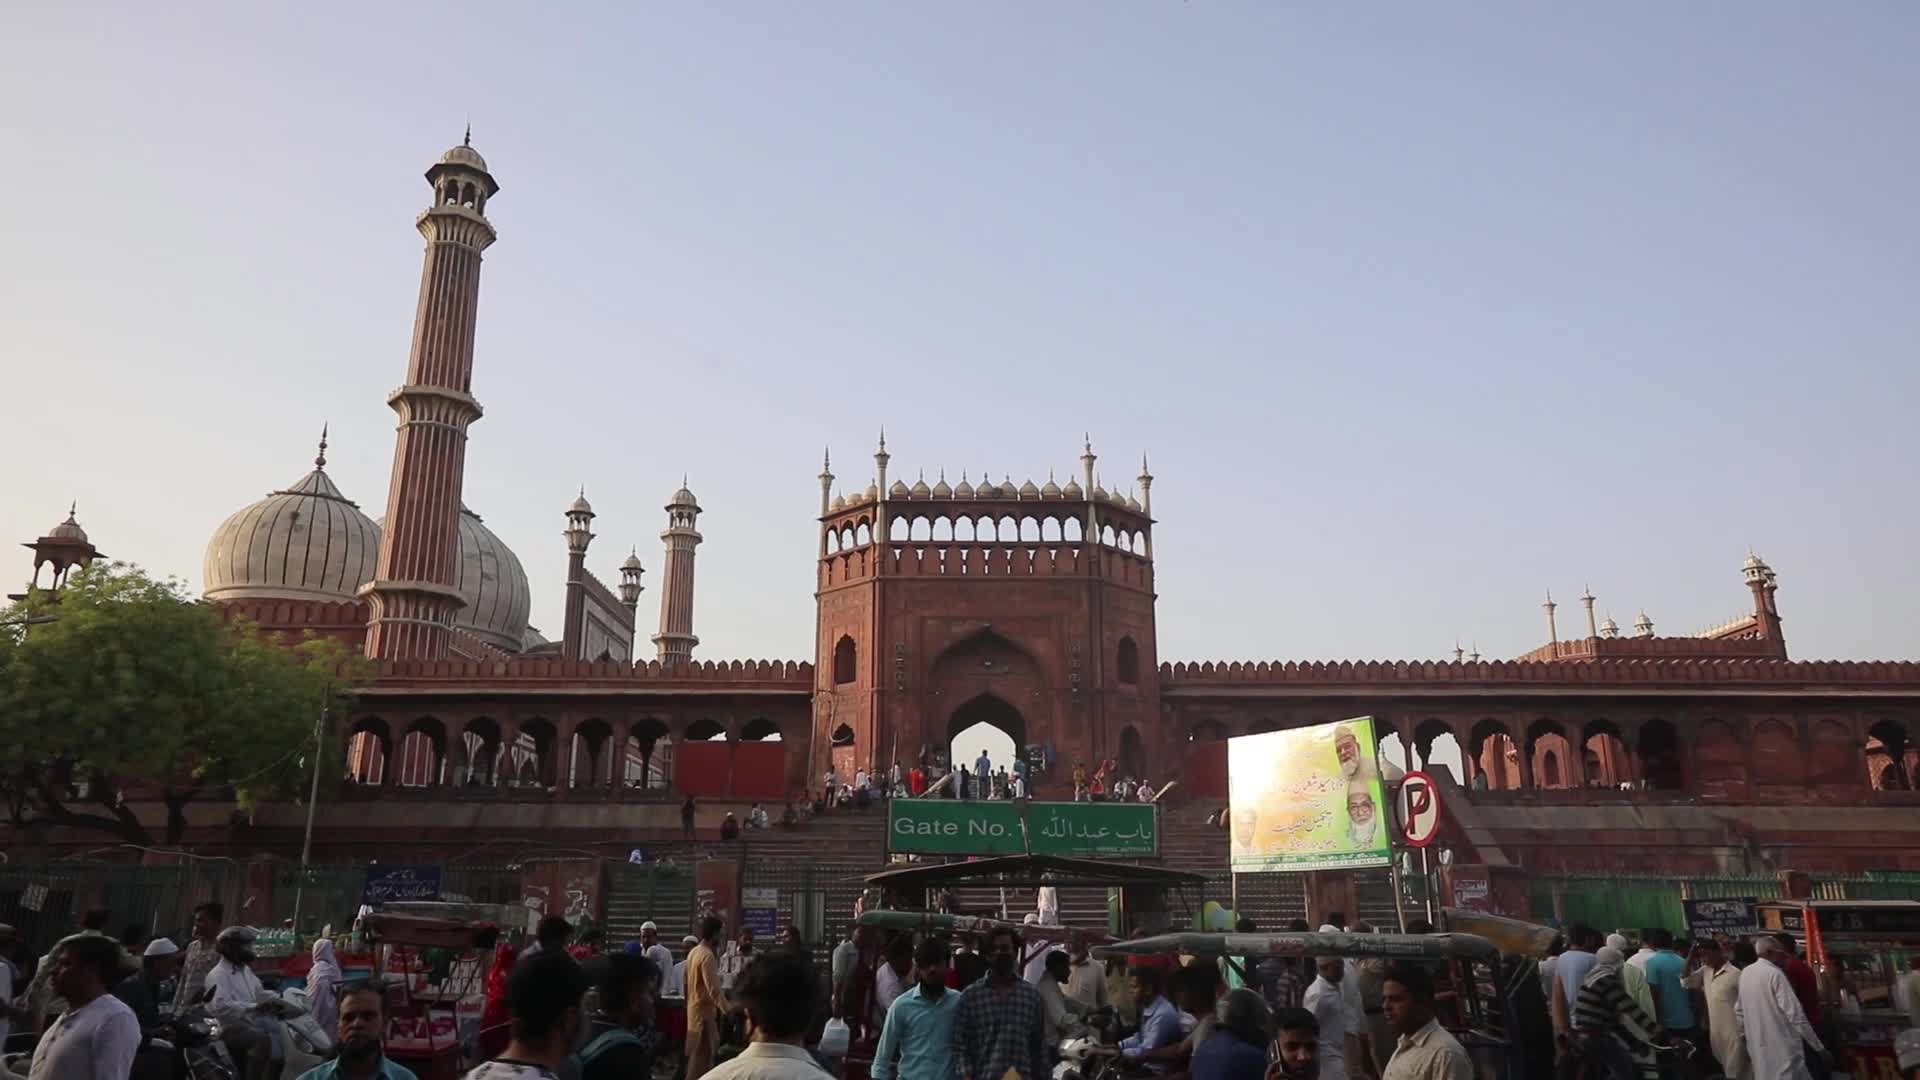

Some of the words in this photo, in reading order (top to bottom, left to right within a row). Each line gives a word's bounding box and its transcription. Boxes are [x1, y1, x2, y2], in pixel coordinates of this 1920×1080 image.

[1405, 783, 1430, 834] P
[894, 817, 958, 836] Gate
[1040, 809, 1073, 839] الله
[1076, 825, 1110, 840] عبد
[1115, 822, 1152, 842] باب
